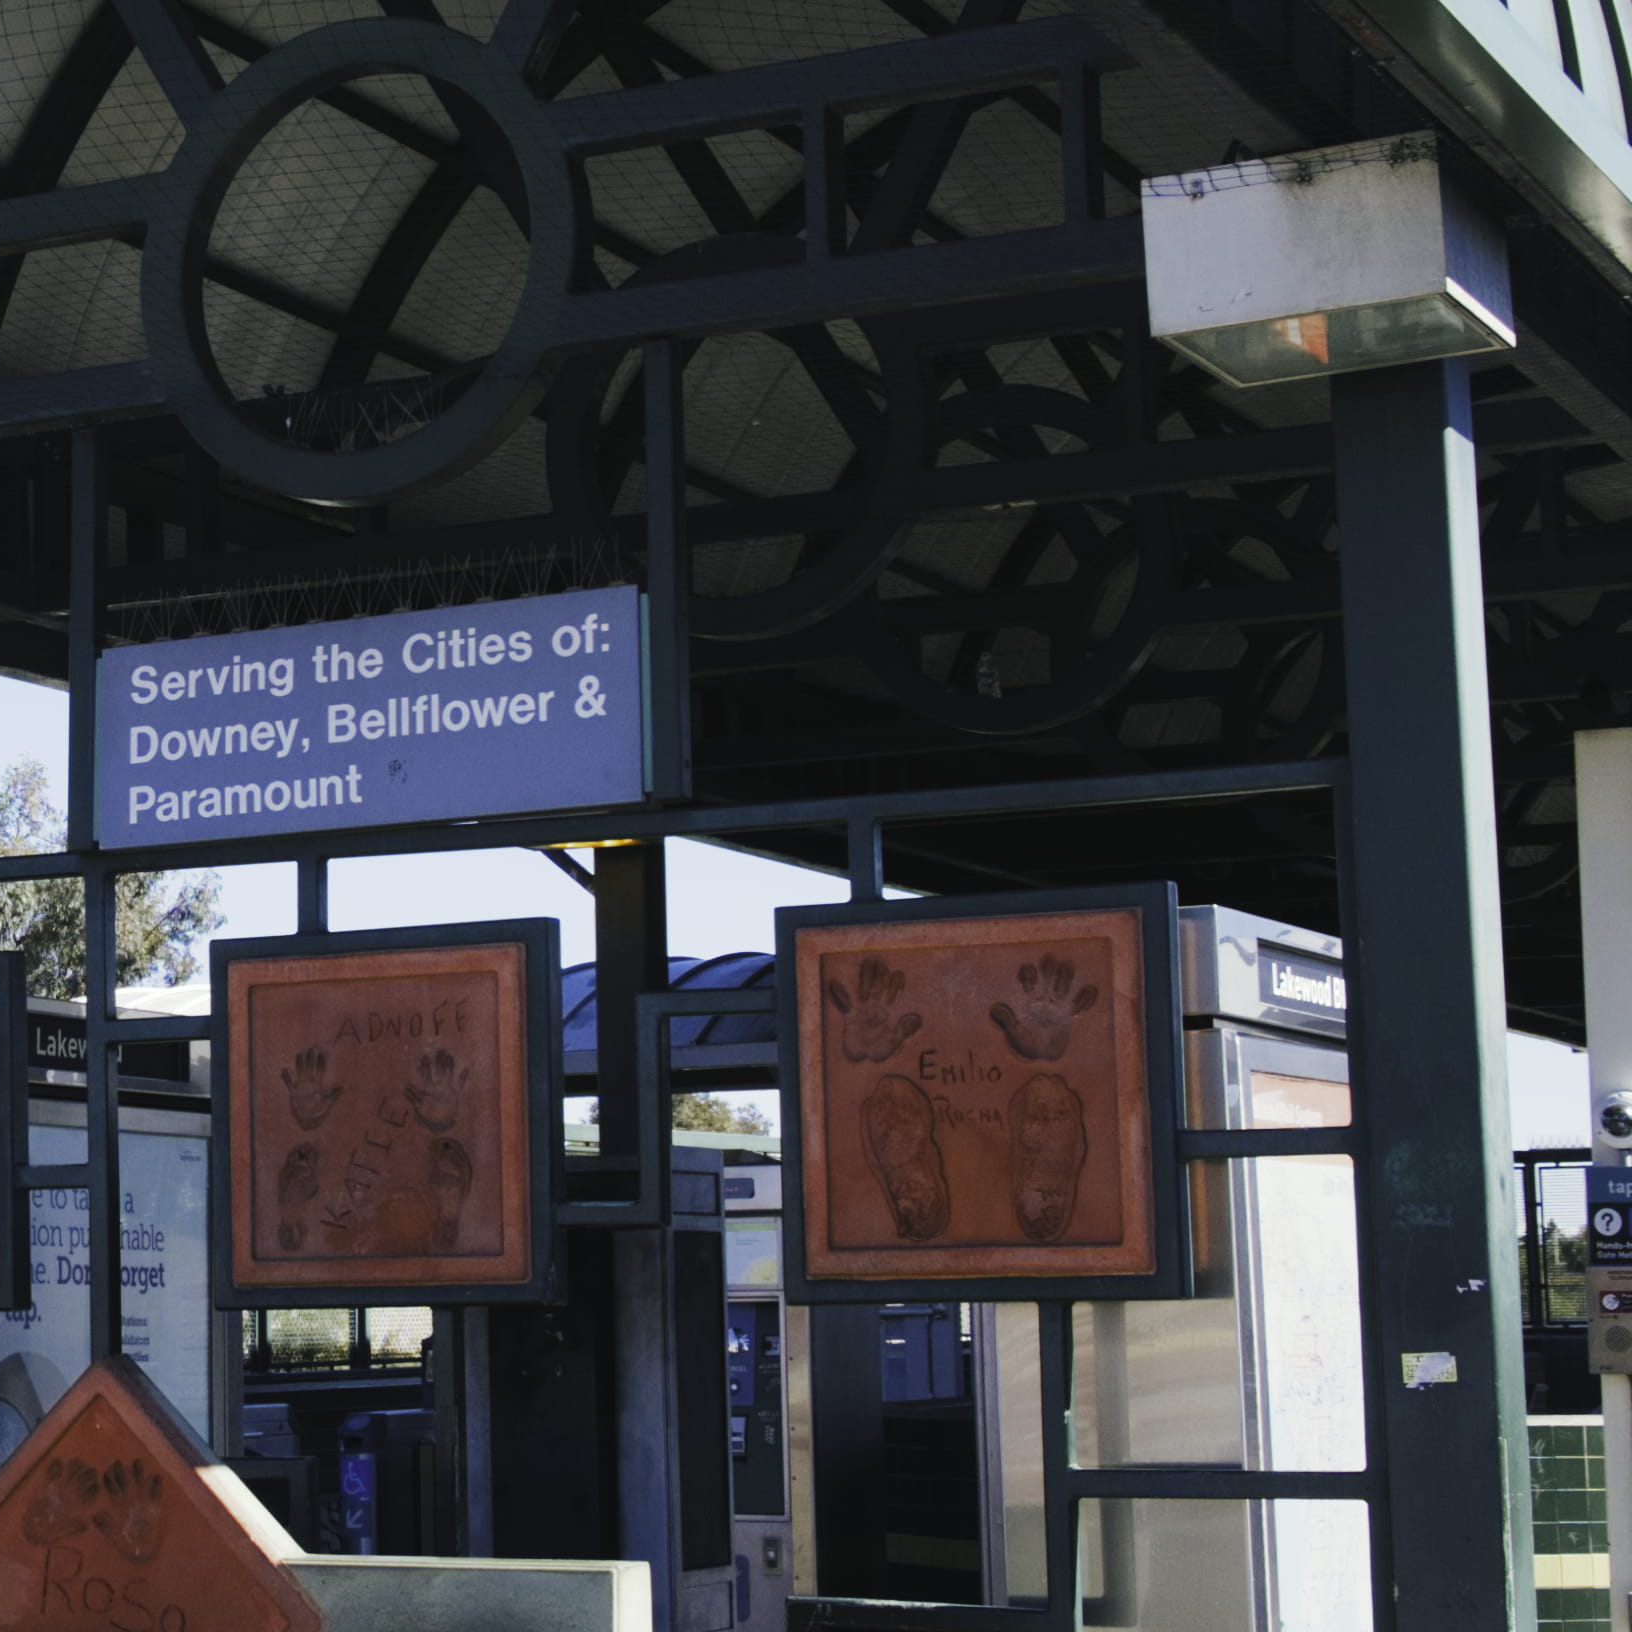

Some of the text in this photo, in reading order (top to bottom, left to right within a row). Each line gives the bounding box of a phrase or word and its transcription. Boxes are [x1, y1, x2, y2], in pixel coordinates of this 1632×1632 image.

[131, 613, 610, 705] Serving the Cities of:
[130, 675, 607, 764] Downey, Bellflower &
[130, 765, 363, 825] Paramount
[1271, 961, 1332, 1008] Lakewood
[120, 1263, 166, 1295] orget
